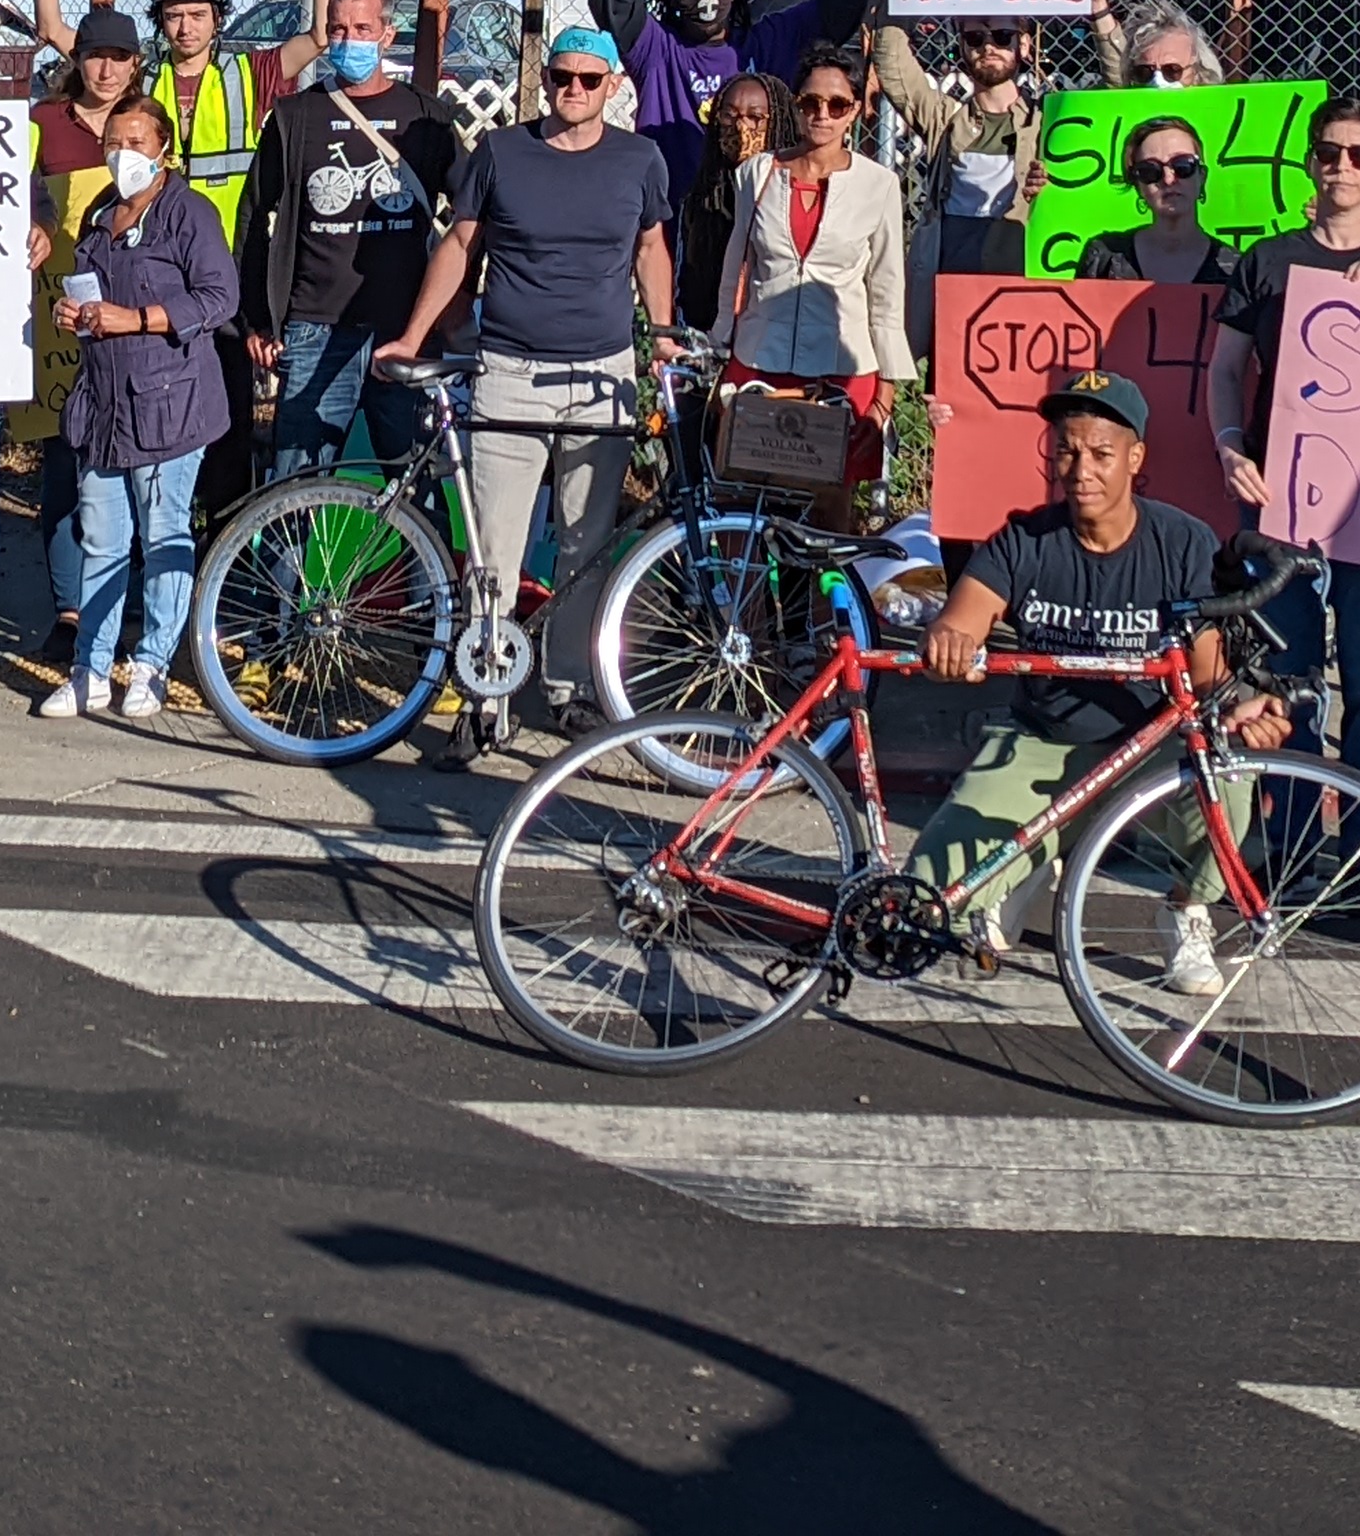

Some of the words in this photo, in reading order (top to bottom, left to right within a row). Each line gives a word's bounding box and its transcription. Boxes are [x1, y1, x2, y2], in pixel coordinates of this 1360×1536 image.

[1216, 92, 1311, 215] 4
[975, 321, 1092, 374] STOP
[1146, 292, 1210, 417] 4
